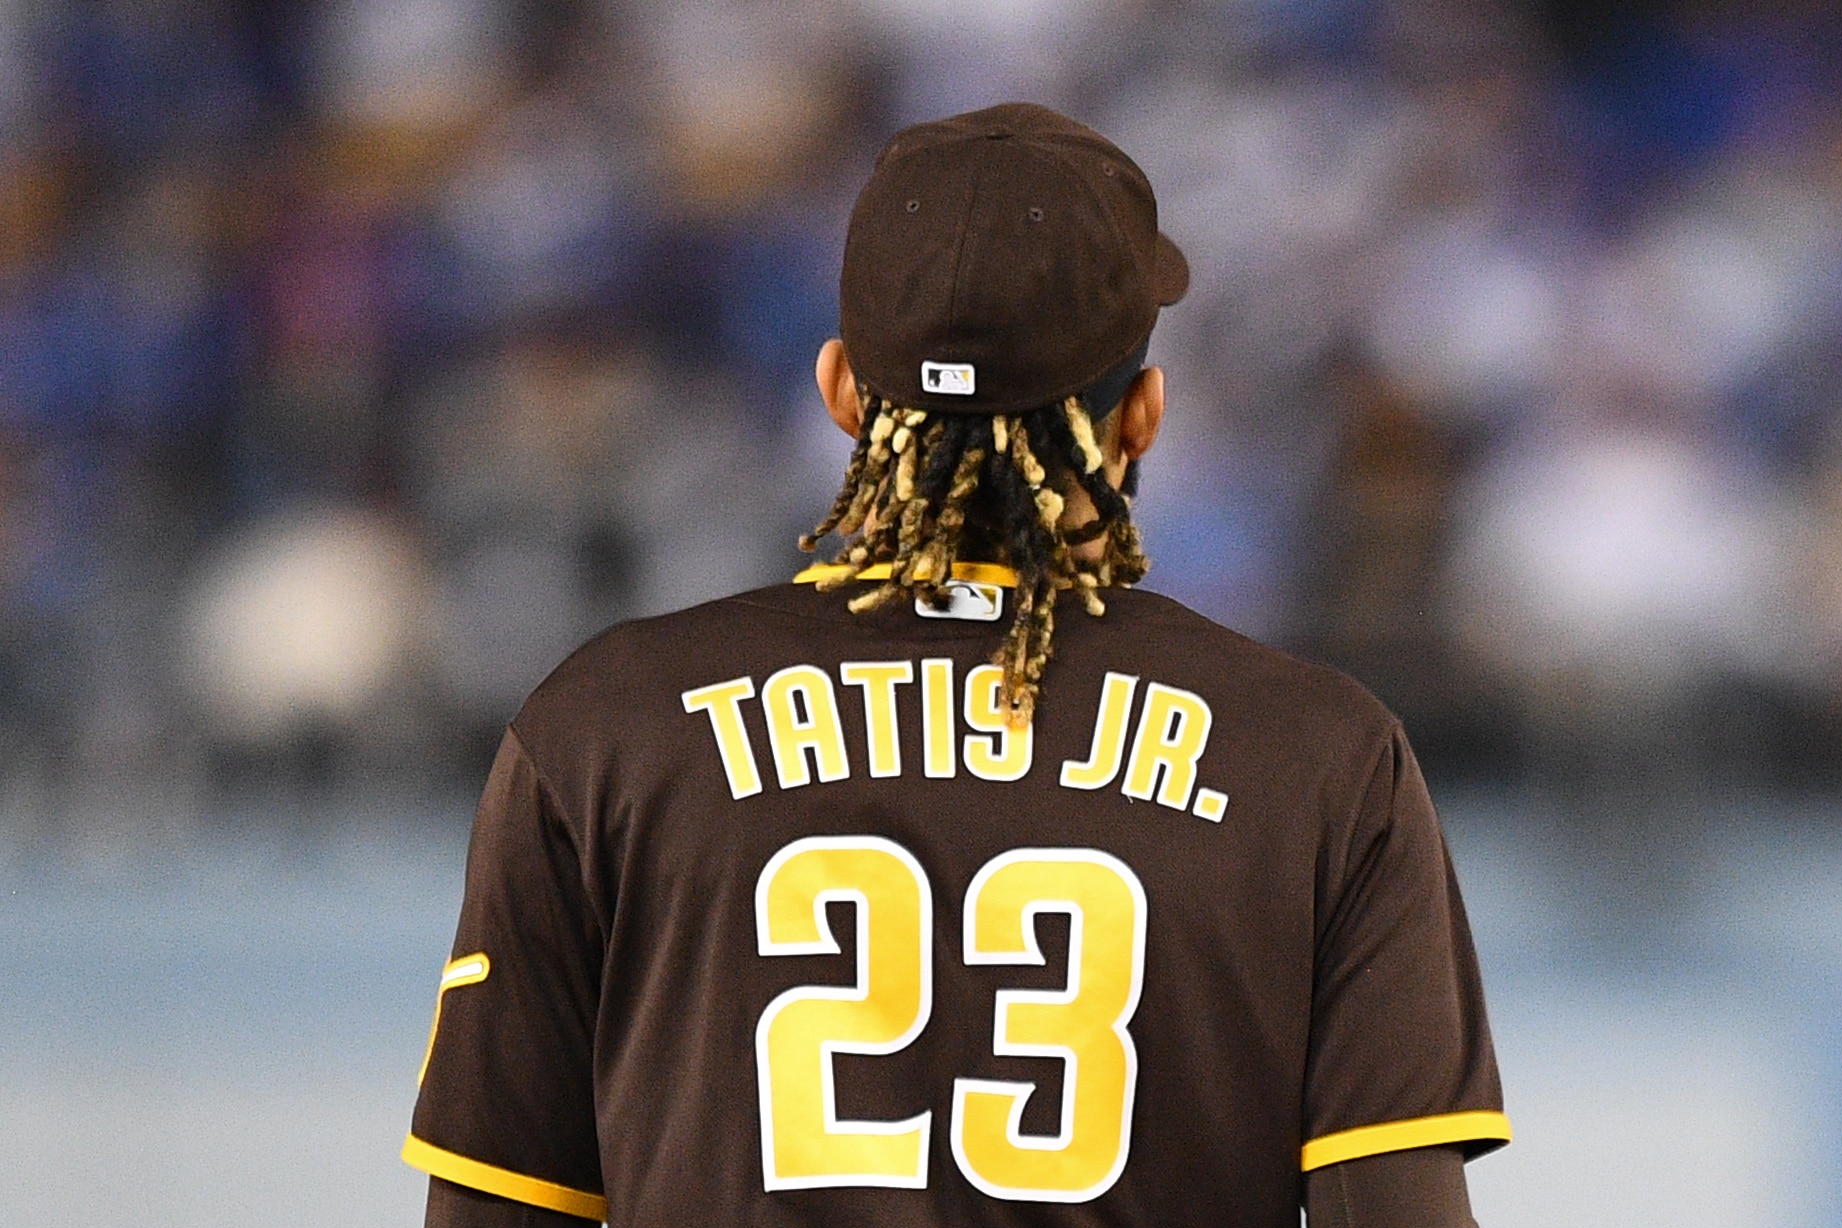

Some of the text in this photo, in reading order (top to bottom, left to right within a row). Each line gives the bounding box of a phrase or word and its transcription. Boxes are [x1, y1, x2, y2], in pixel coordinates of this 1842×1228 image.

[681, 658, 1229, 822] TATIS JR.
[755, 835, 1147, 1203] 23
